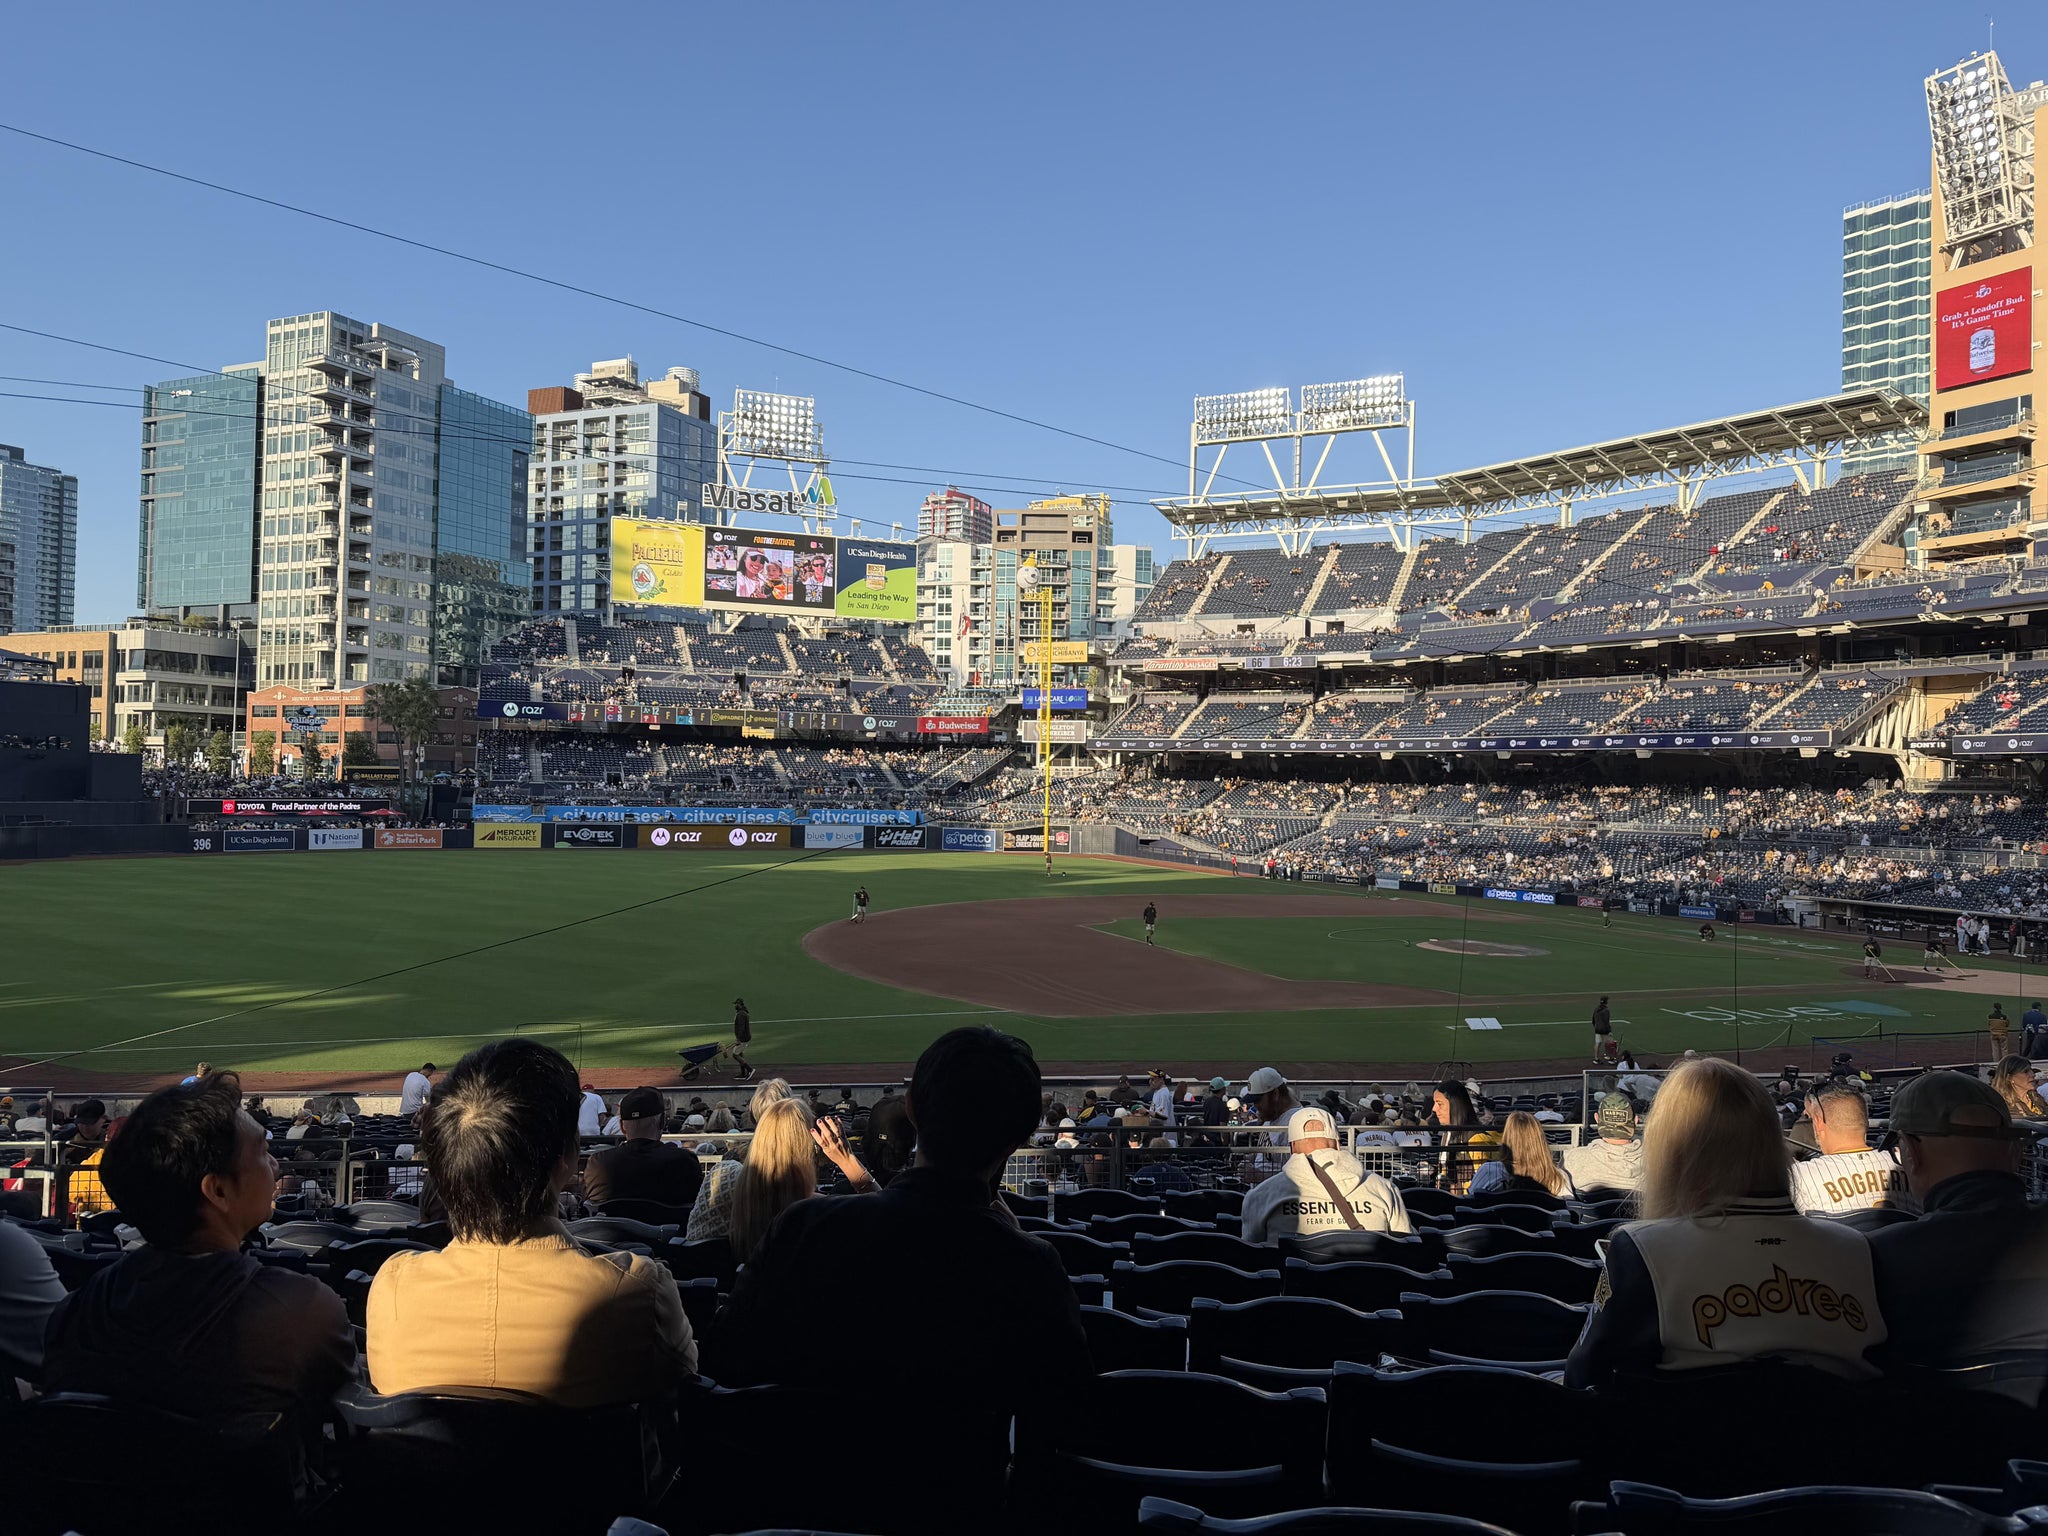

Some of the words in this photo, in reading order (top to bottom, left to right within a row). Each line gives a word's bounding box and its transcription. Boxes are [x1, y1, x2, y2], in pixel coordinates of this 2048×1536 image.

[1942, 311, 1962, 322] Grab
[1972, 300, 2003, 315] Leadoff
[2006, 295, 2025, 306] Bud.
[1952, 320, 1964, 329] It's
[1966, 314, 1990, 325] Game
[1992, 307, 2015, 318] Time
[708, 482, 799, 513] Viasat
[870, 550, 887, 559] Diego
[887, 552, 906, 560] Health
[848, 591, 878, 601] Leading
[893, 594, 909, 603] Way
[1146, 661, 1184, 669] Tarantino
[1284, 657, 1302, 666] 6:23
[522, 705, 544, 714] razr
[630, 710, 635, 718] F
[287, 717, 327, 725] Gallagher
[879, 720, 897, 728] razr
[939, 721, 980, 730] Budweiser
[684, 809, 774, 823] citycruises
[812, 811, 895, 823] citycruises
[564, 828, 615, 840] EVOTEK
[674, 832, 702, 842] razr
[751, 832, 777, 842] razr
[959, 832, 991, 844] petco
[193, 839, 211, 850] 396
[1496, 890, 1516, 899] petco
[1532, 893, 1554, 902] petco
[1659, 1006, 1843, 1021] blue
[1823, 1169, 1909, 1203] BOGAERT
[1282, 1201, 1372, 1216] ESSENTALS
[1693, 1264, 1868, 1350] padres
